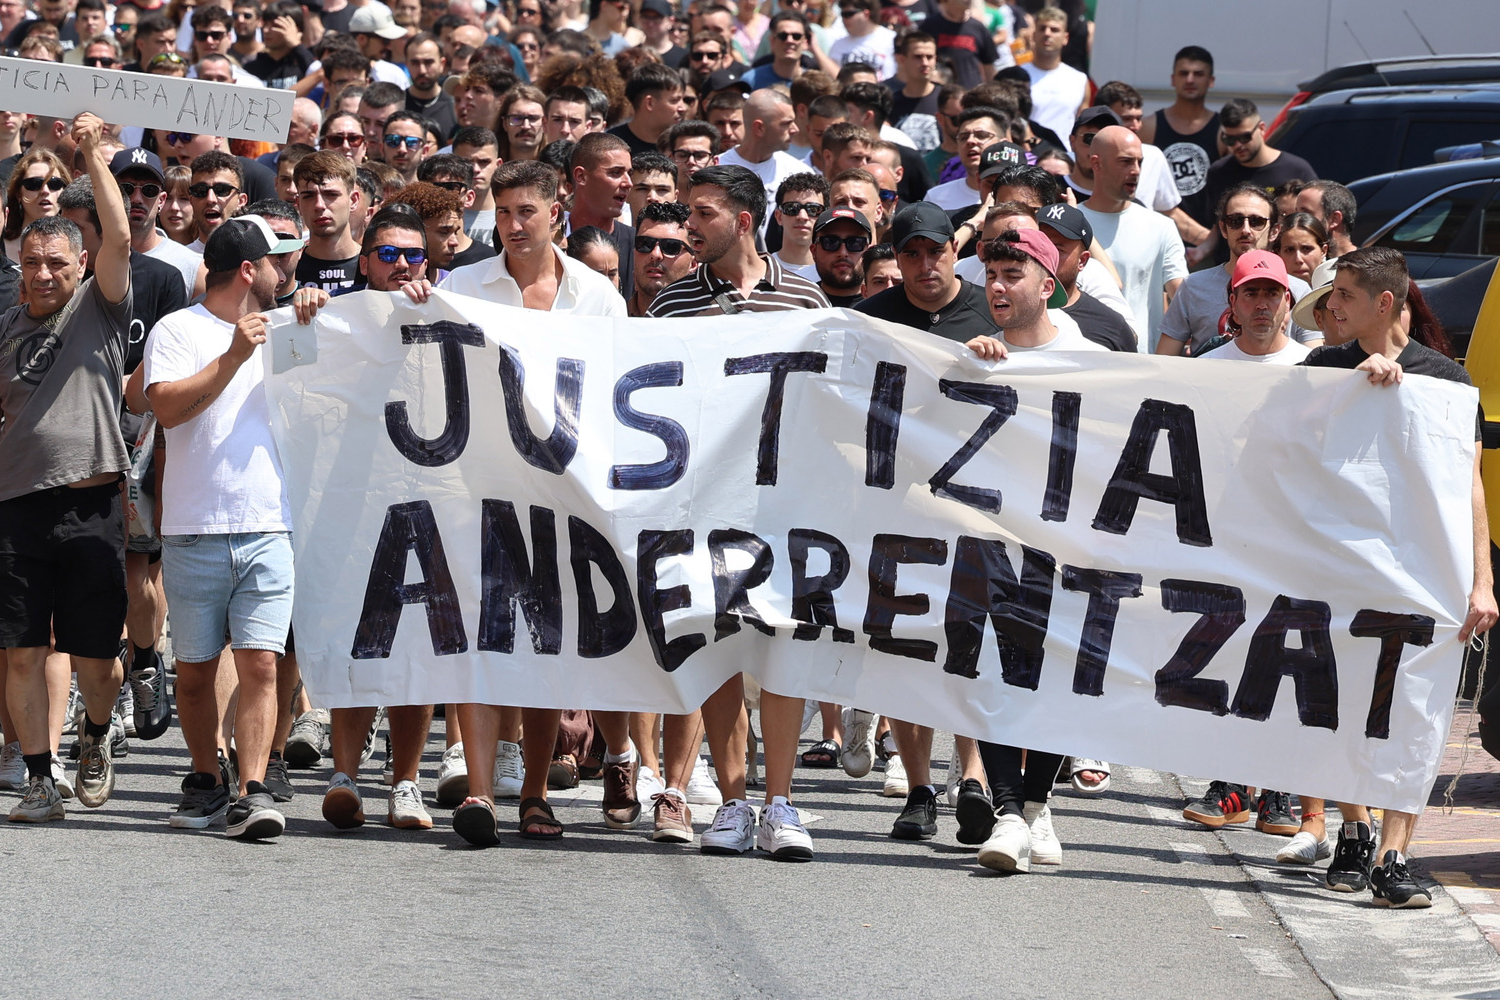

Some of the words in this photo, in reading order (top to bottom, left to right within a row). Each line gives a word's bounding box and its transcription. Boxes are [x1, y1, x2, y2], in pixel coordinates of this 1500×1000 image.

[92, 73, 169, 108] PARA
[176, 82, 283, 134] ANDER
[987, 151, 1019, 164] ICON
[318, 268, 347, 280] SOUL
[384, 319, 1214, 547] JUSTIZIA
[351, 498, 1437, 740] ANDERRENTZAT
